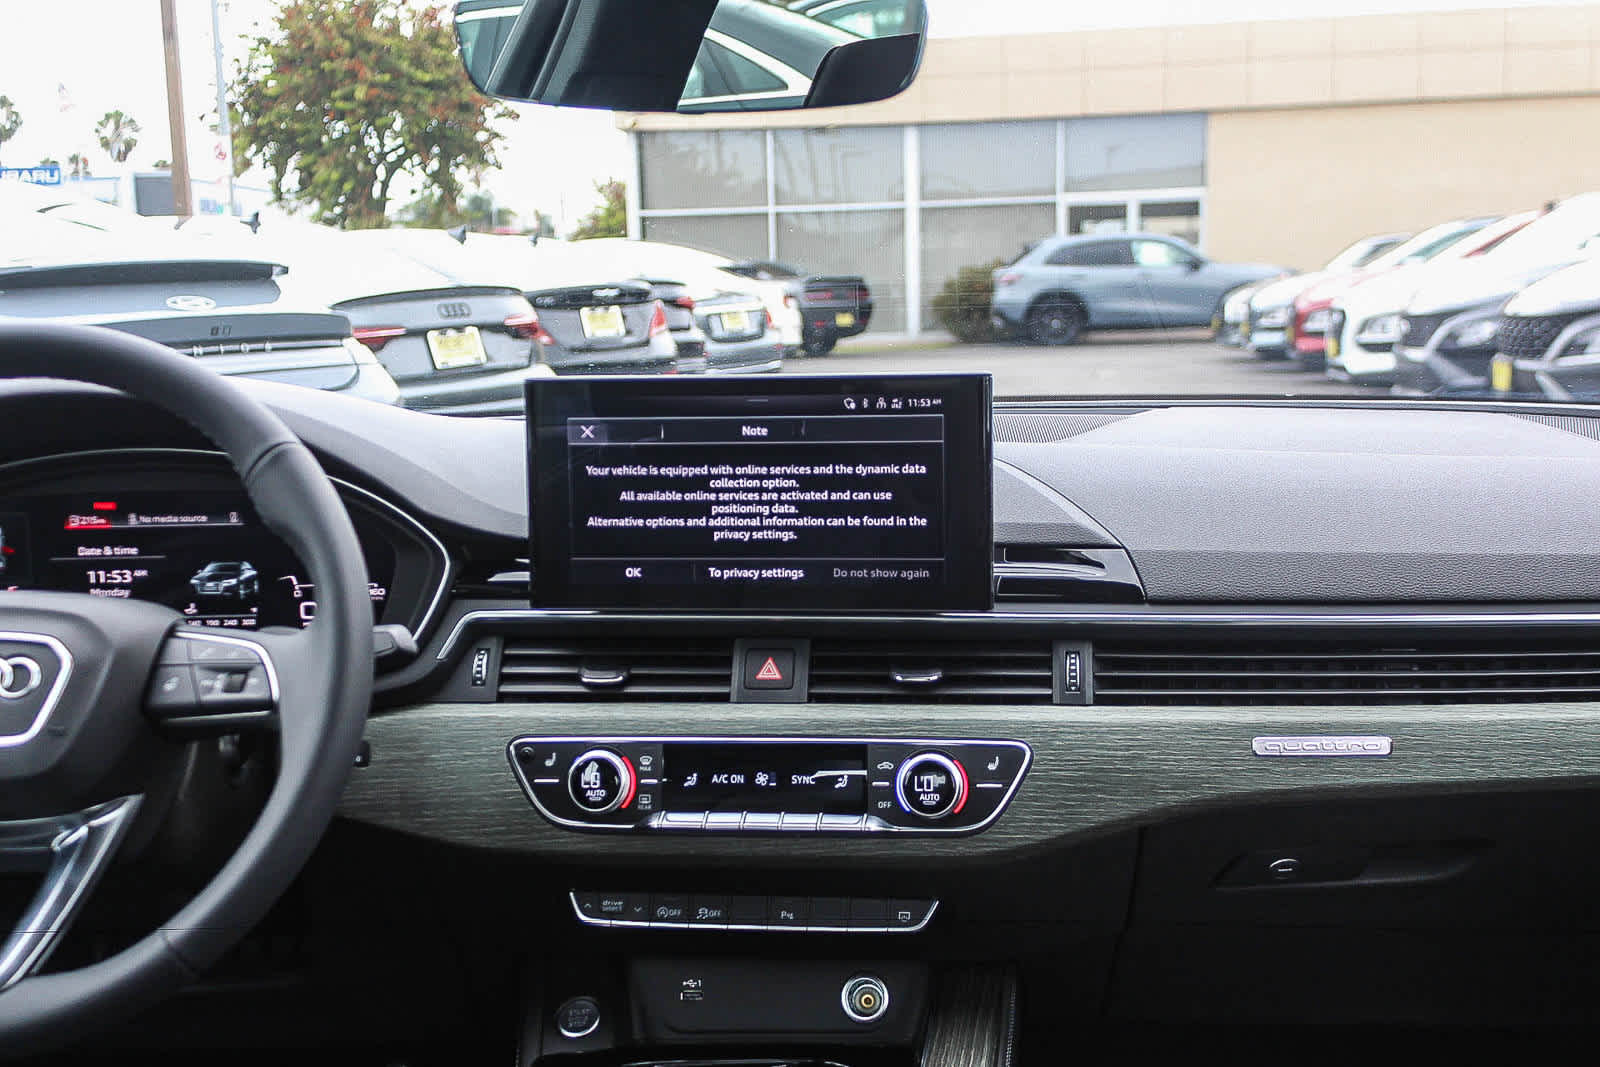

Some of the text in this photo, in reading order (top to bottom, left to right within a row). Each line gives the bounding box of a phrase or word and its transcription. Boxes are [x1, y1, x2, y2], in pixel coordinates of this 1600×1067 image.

[908, 398, 931, 407] 11:53
[742, 425, 768, 436] Note
[586, 464, 927, 478] Your vehicle is equipped with online services and the dynamic data
[710, 478, 799, 490] collection option.
[620, 490, 892, 501] All available online services are activated and can use
[711, 503, 799, 516] positioning data.
[587, 516, 927, 528] Alternative options and additional information can be found in the
[713, 529, 798, 541] privacy settings.
[114, 545, 139, 555] time
[87, 570, 132, 583] 11:53
[625, 567, 642, 577] OK
[708, 567, 804, 580] To privacy settings
[833, 567, 930, 580] Do not show again
[1264, 741, 1381, 753] quattro
[712, 774, 744, 784] A/C ON
[791, 774, 816, 785] SYNC
[585, 789, 606, 797] AUTO
[919, 793, 940, 801] AUTO
[877, 801, 892, 809] OFF
[709, 909, 721, 917] OFF
